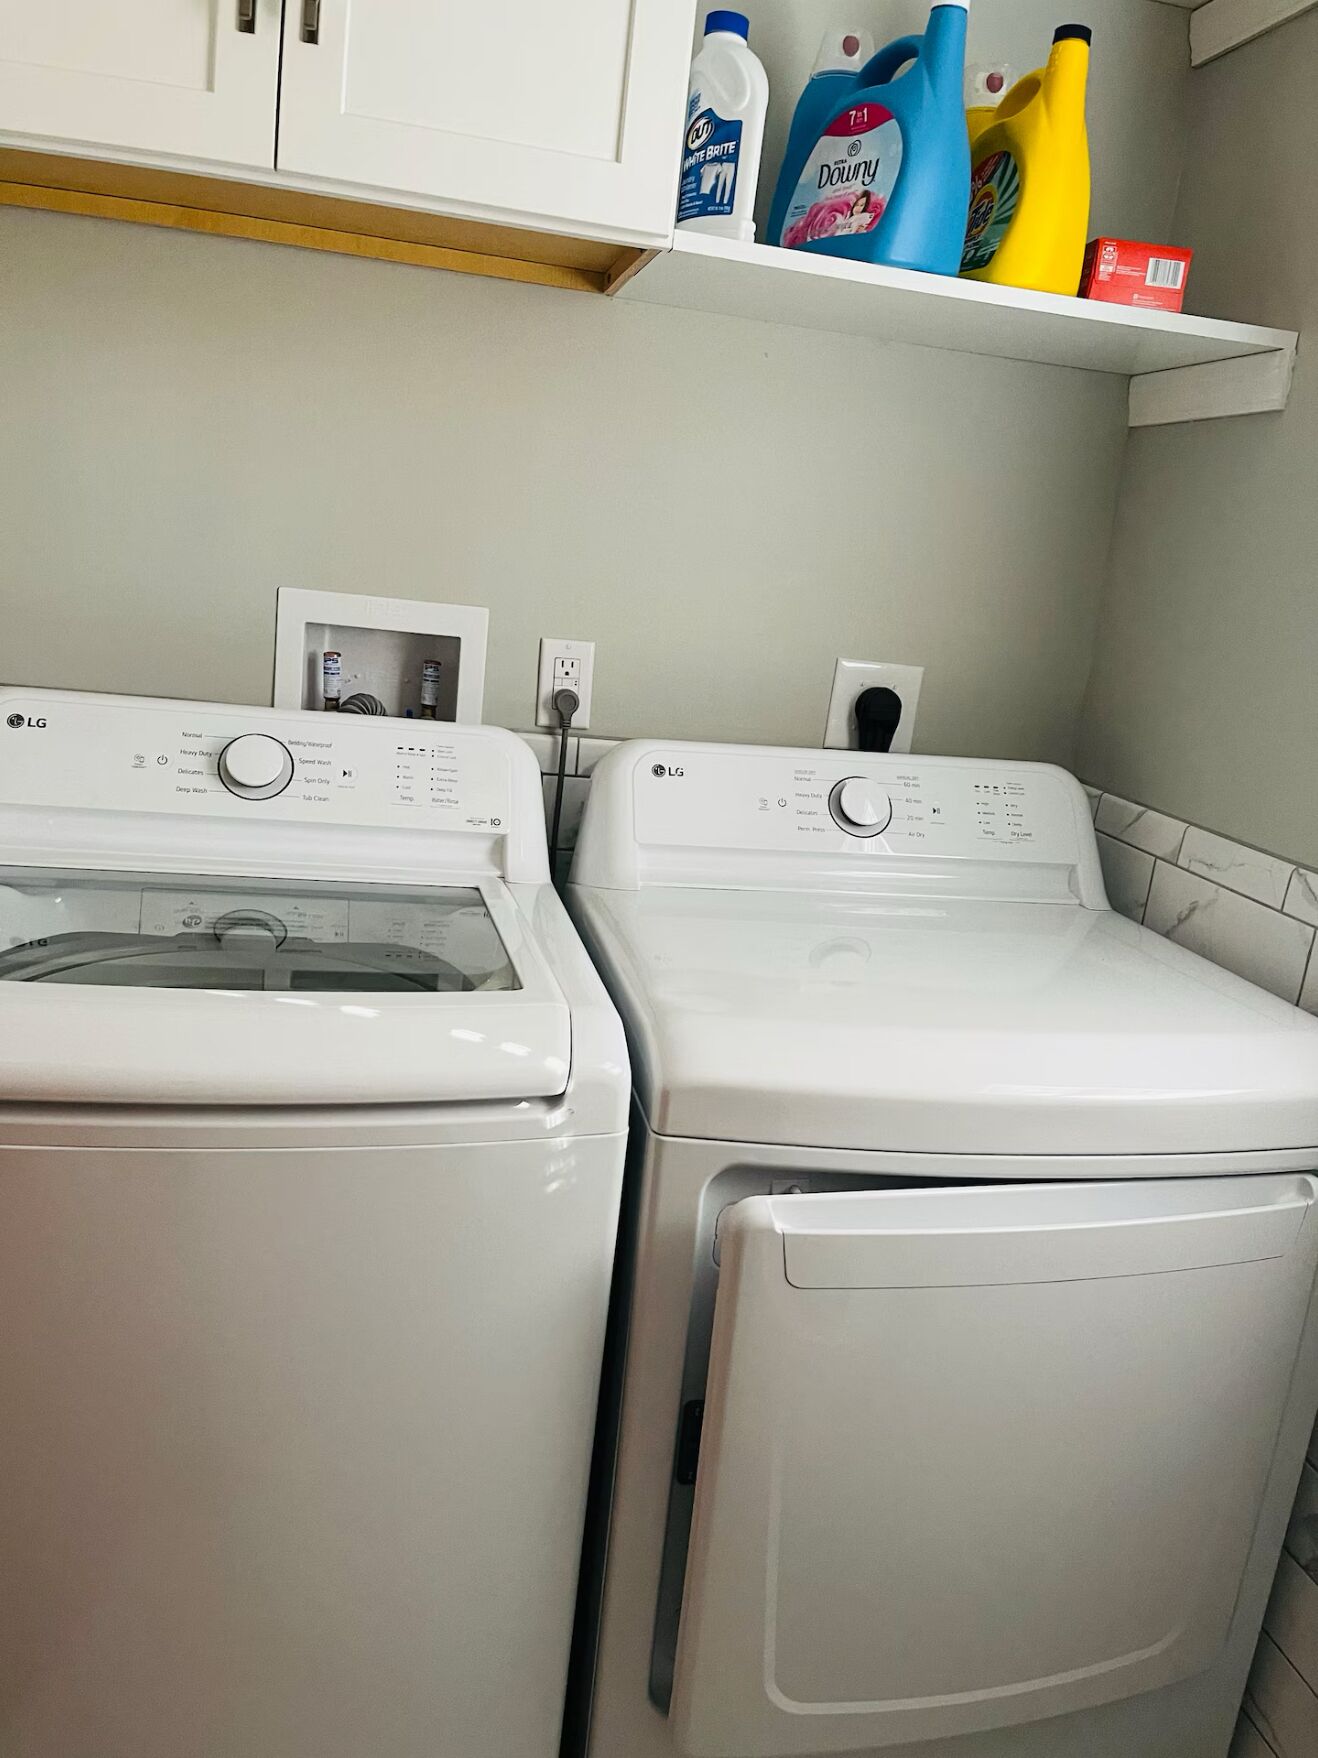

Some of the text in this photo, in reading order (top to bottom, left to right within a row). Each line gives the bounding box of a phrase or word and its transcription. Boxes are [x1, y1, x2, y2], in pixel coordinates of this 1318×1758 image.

[705, 141, 737, 161] BRITE
[818, 158, 880, 190] Downy
[27, 717, 48, 729] LG
[182, 731, 203, 739] Normal
[180, 749, 213, 758] Heavy Duty
[299, 757, 316, 765] Speed
[177, 768, 204, 776] Delicates
[667, 766, 684, 777] LG
[303, 776, 330, 785] Spin Only
[176, 786, 191, 794] Deep
